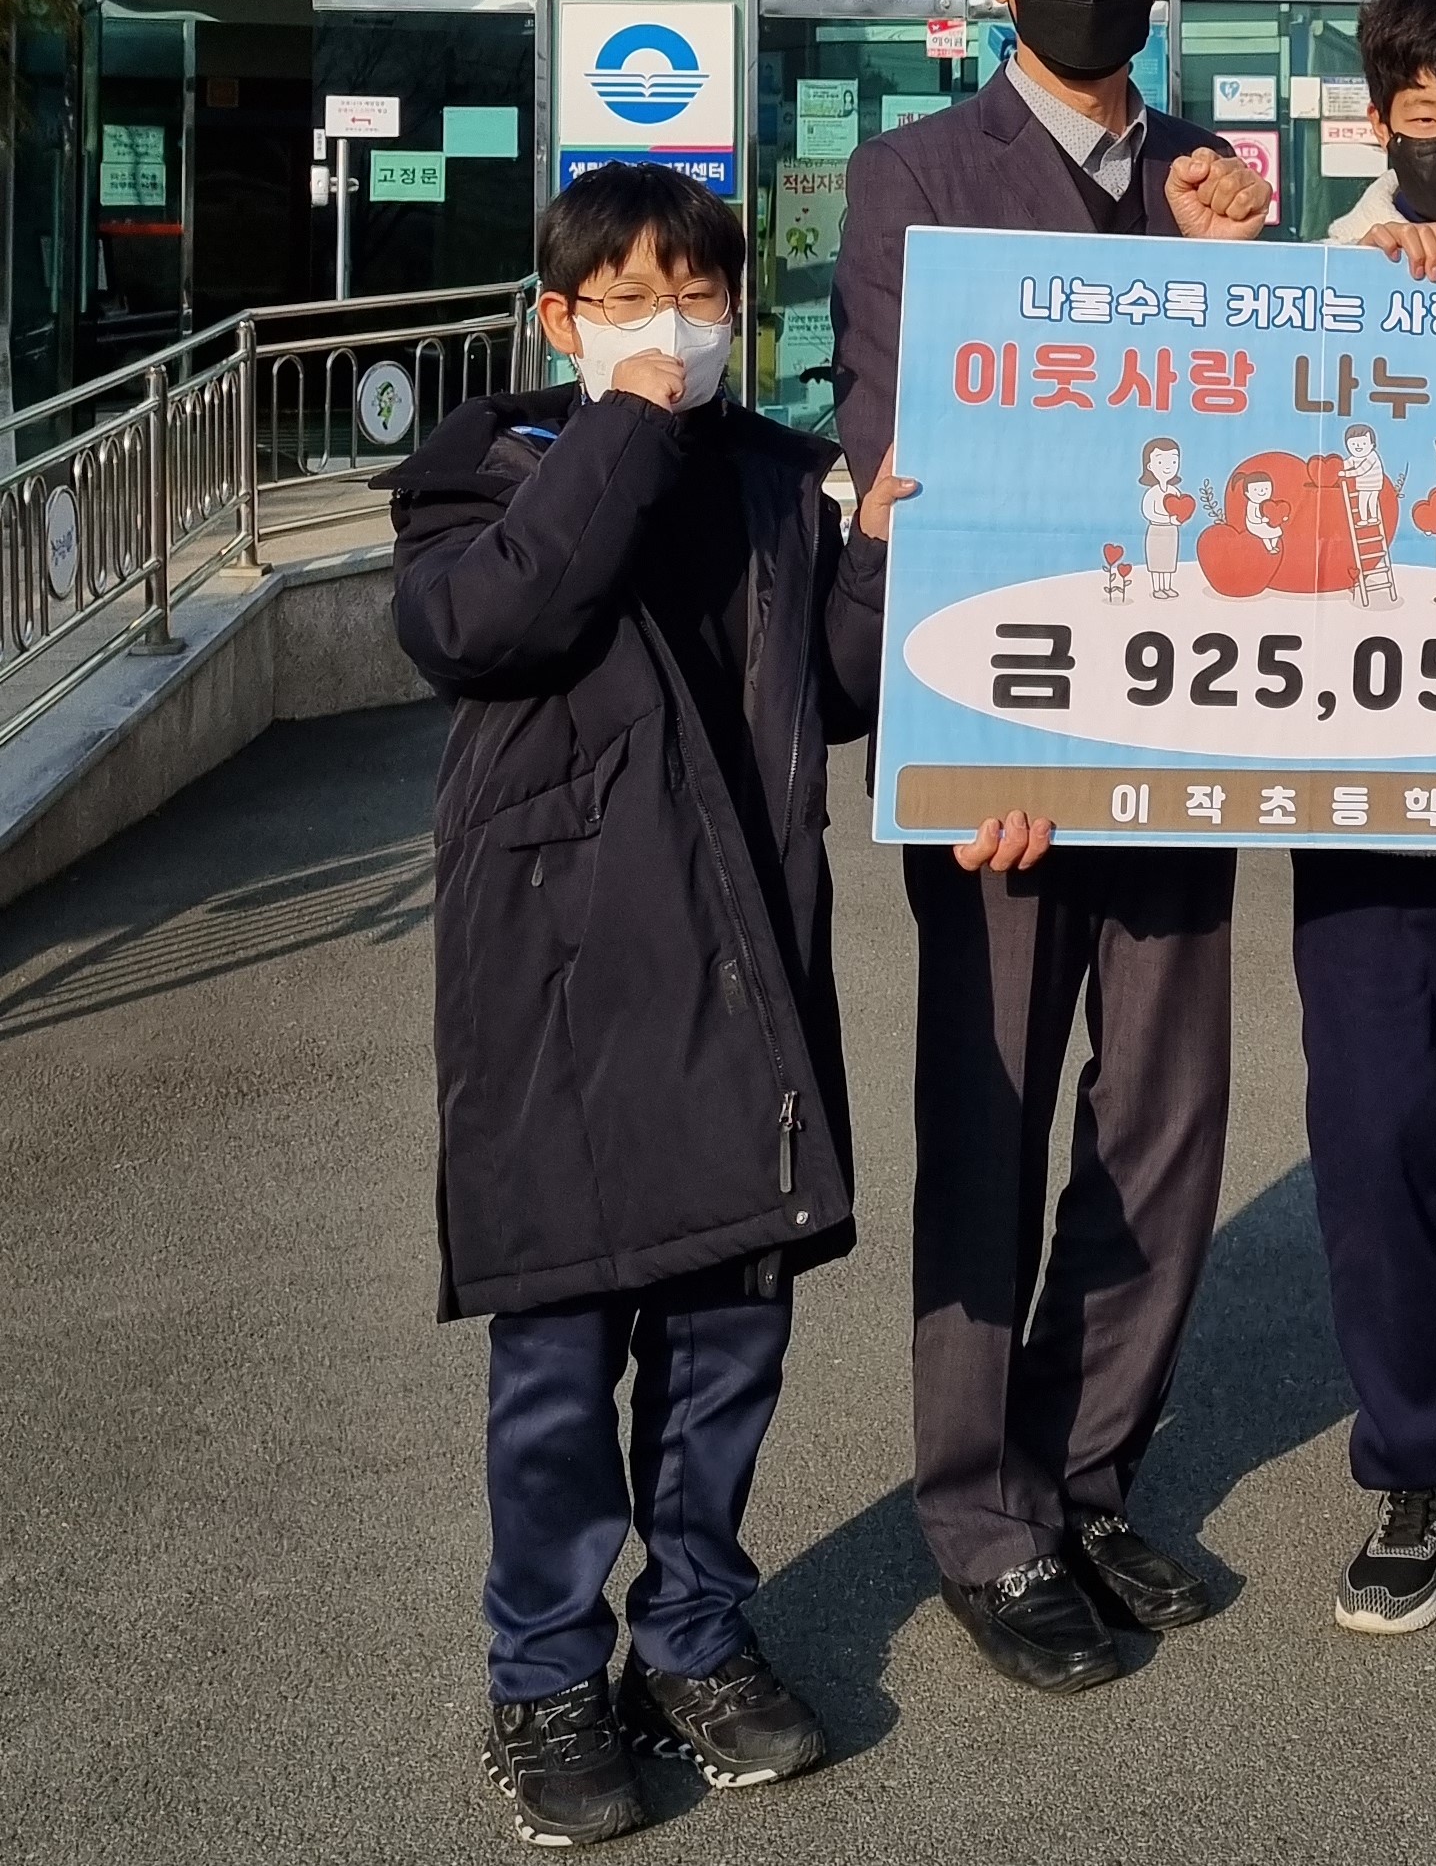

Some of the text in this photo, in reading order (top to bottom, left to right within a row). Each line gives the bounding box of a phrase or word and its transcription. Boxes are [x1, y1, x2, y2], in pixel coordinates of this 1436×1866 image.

[378, 167, 438, 185] 고정문
[1019, 275, 1209, 328] 나눌수록
[1225, 283, 1366, 333] 커지는
[953, 341, 1255, 415] 이웃사랑
[990, 622, 1076, 710] 금
